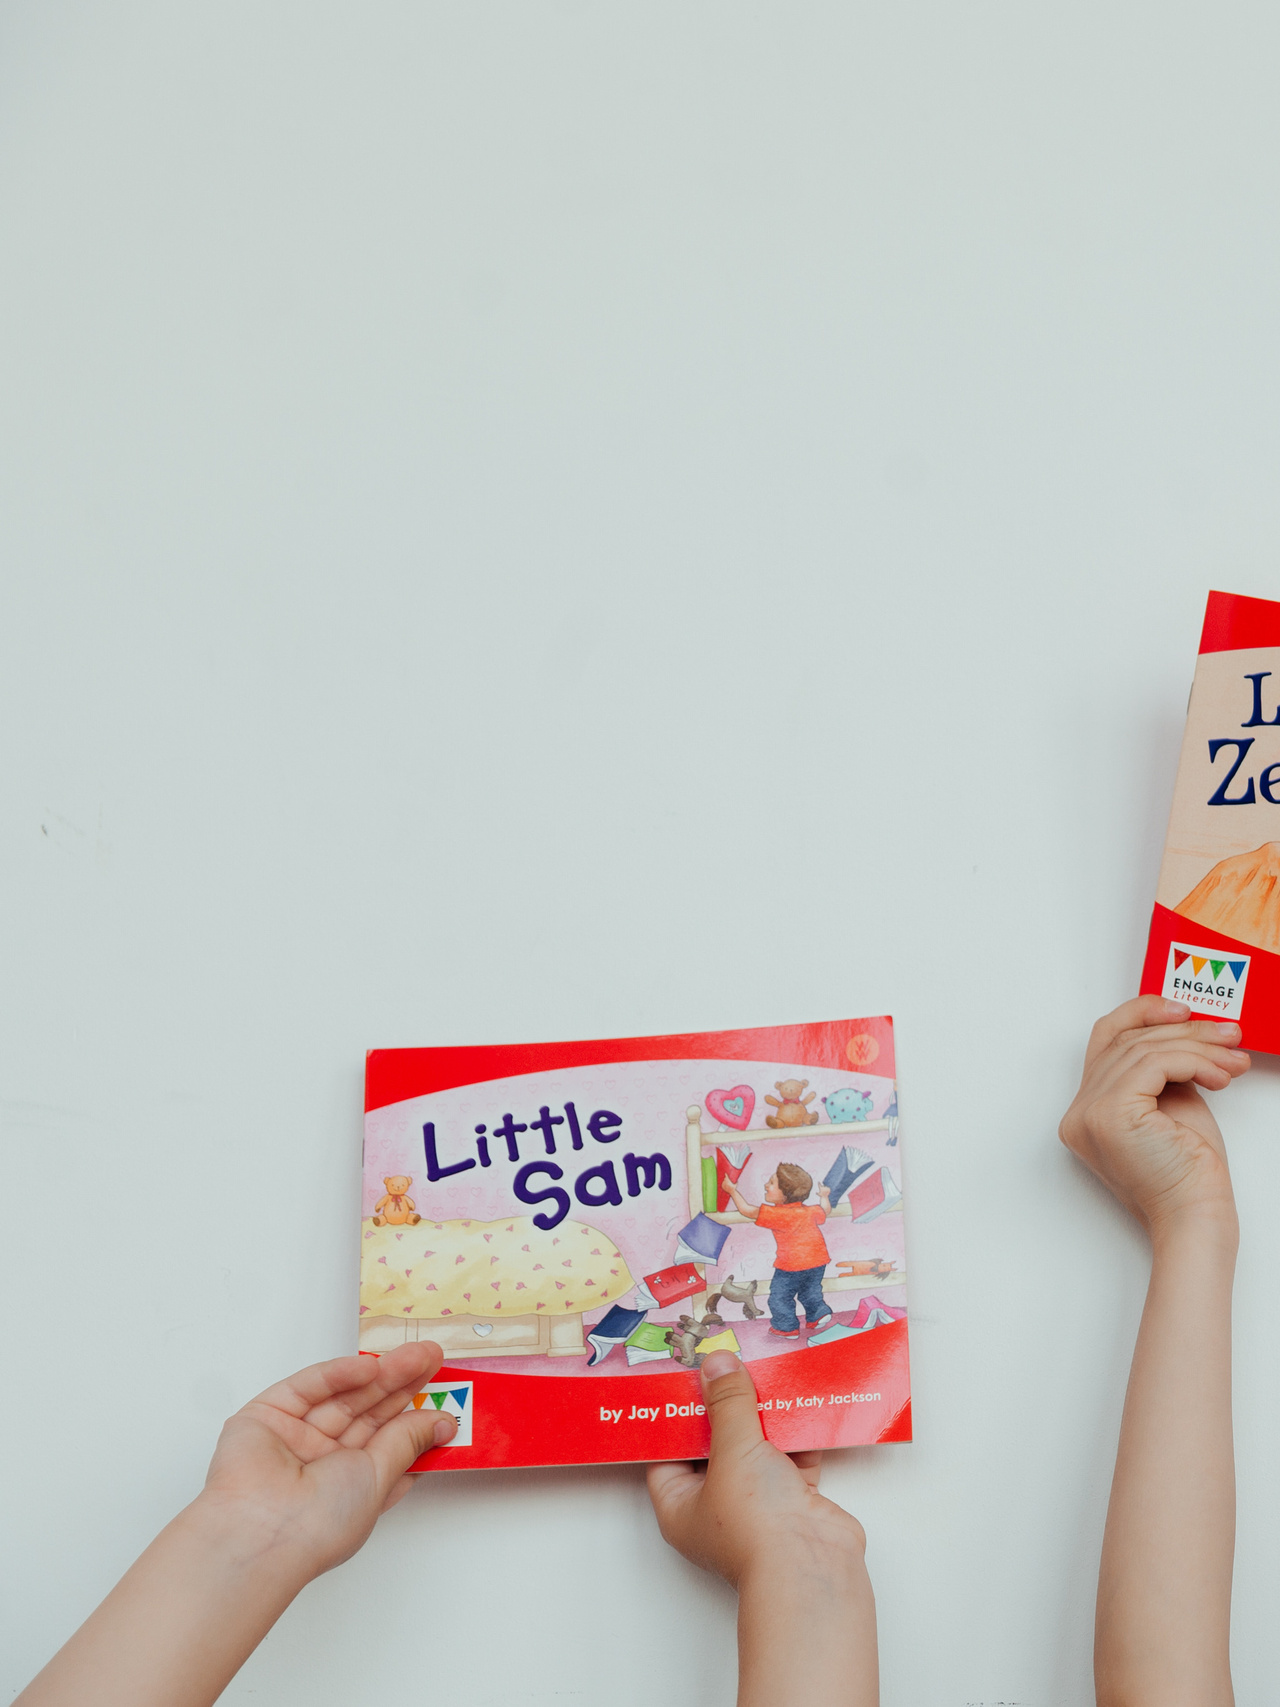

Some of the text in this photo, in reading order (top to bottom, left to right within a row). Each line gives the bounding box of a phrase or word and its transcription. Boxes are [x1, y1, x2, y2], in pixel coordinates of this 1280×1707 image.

[1173, 977, 1235, 999] ENGAGE
[1173, 990, 1230, 1010] Literacy
[422, 1101, 623, 1182] Little
[513, 1152, 672, 1231] Sam
[776, 1398, 793, 1412] by
[796, 1395, 825, 1410] Katy
[828, 1391, 882, 1406] Jackson
[600, 1402, 706, 1423] by Jay Dale
